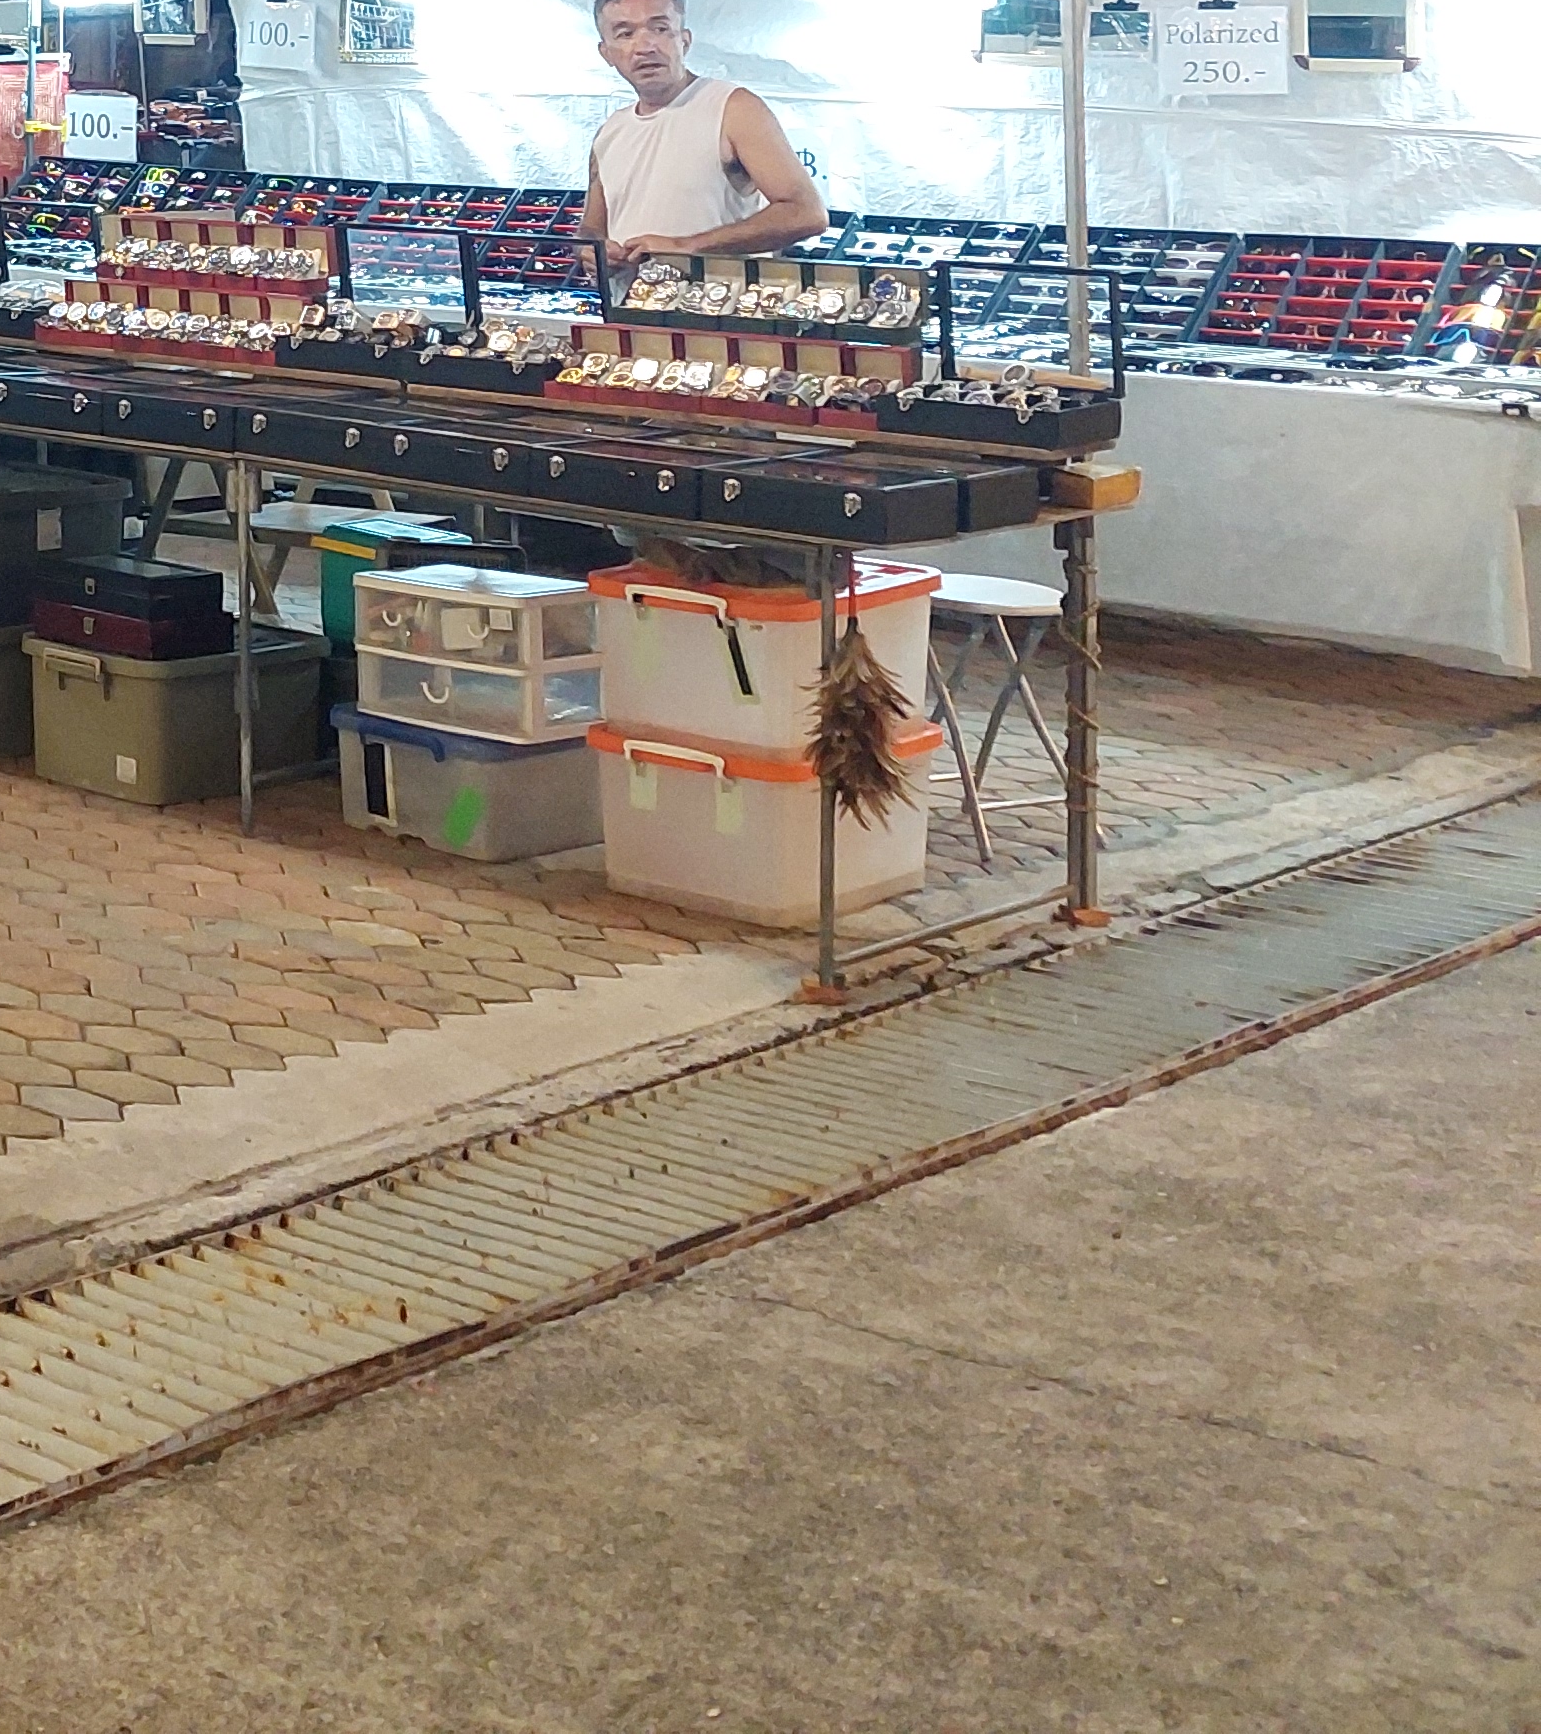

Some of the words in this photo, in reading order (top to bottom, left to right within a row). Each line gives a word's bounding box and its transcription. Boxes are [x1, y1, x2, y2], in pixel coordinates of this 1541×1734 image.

[247, 20, 310, 48] 100.-
[1166, 20, 1280, 45] Polarized
[1182, 60, 1267, 84] 250.-
[69, 111, 134, 140] 100.-
